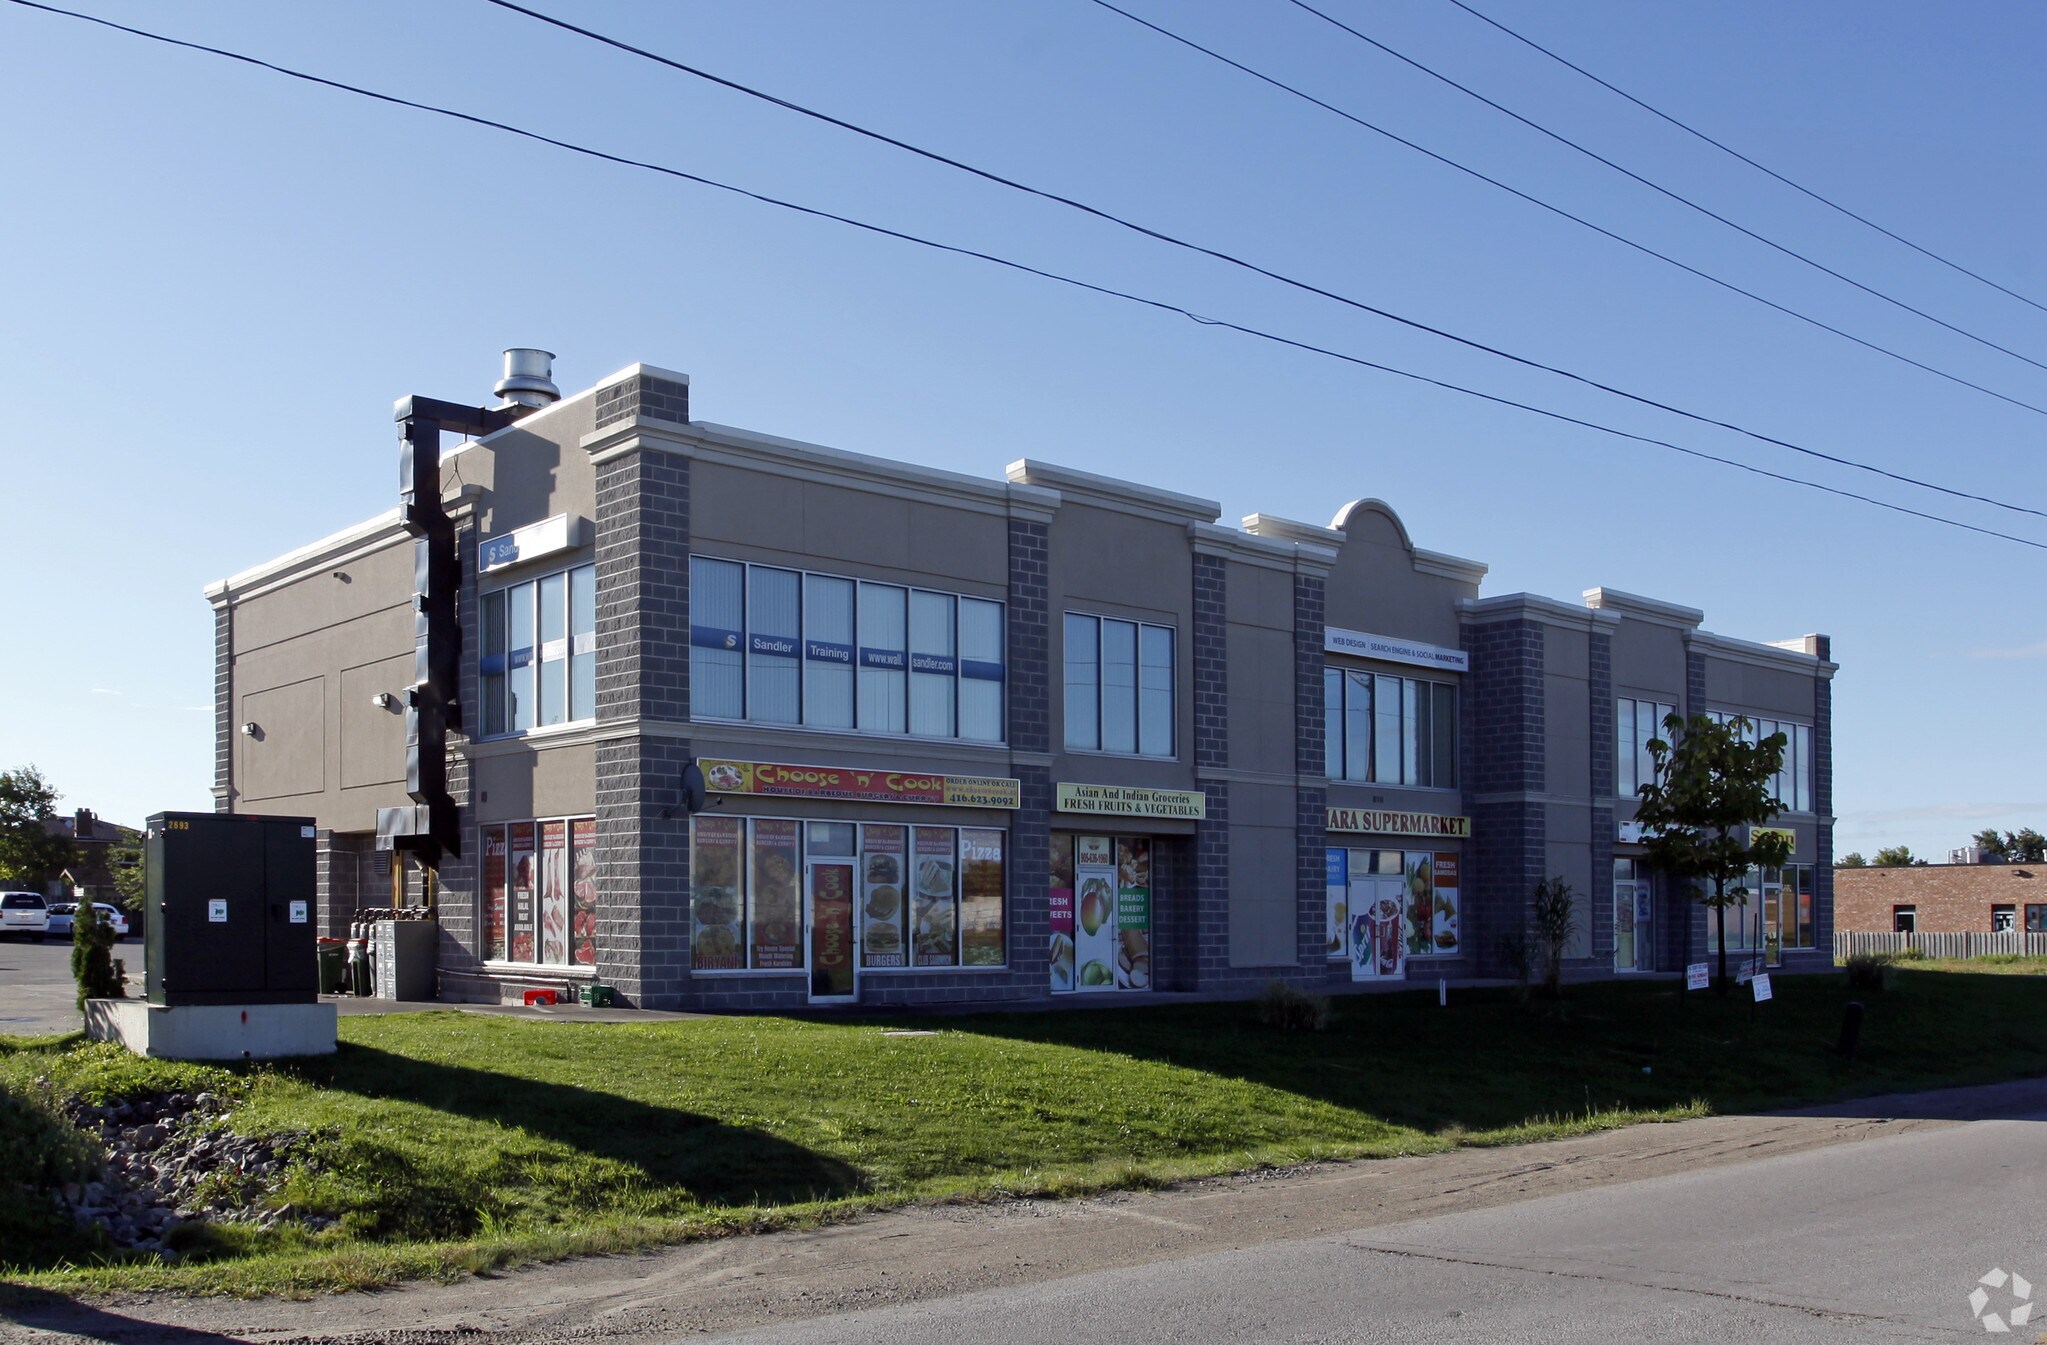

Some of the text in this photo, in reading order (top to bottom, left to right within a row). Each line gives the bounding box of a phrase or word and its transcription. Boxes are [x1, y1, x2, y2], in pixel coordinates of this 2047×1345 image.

[753, 638, 793, 653] Sandler
[810, 644, 849, 661] Training
[912, 657, 954, 671] sandler.com
[1333, 637, 1345, 646] WEB
[1346, 638, 1366, 649] DESIGN
[1370, 643, 1391, 653] SEARCH
[1392, 646, 1411, 656] ENGINE
[1416, 650, 1435, 660] SOCIAL
[1435, 654, 1464, 665] MARKETING
[756, 765, 840, 787] Choose
[885, 773, 942, 791] Cook
[946, 778, 967, 786] ORDER
[968, 779, 990, 787] ONLINE
[1001, 781, 1016, 789] CALL
[763, 786, 795, 795] HOUSE
[796, 788, 807, 796] OF
[856, 791, 894, 800] BURGERS
[1075, 787, 1190, 804] Asian And Indian Groceries
[950, 794, 1014, 806] 416.623.9092
[1064, 798, 1200, 816] FRESH FRUITS & VEGETABLES
[1326, 809, 1465, 836] ARA SUPERMARKET
[485, 836, 505, 857] Pizz
[960, 839, 1002, 861] Pizza
[1326, 854, 1340, 862] RESH
[1326, 865, 1340, 873] AIRY
[1435, 861, 1456, 869] FRESH
[819, 868, 843, 900] Cook
[1049, 898, 1068, 906] RESH
[1120, 894, 1145, 902] BREADS
[1120, 905, 1144, 913] BAKERY
[1118, 916, 1146, 924] DESSERT
[866, 954, 900, 966] BURGERS
